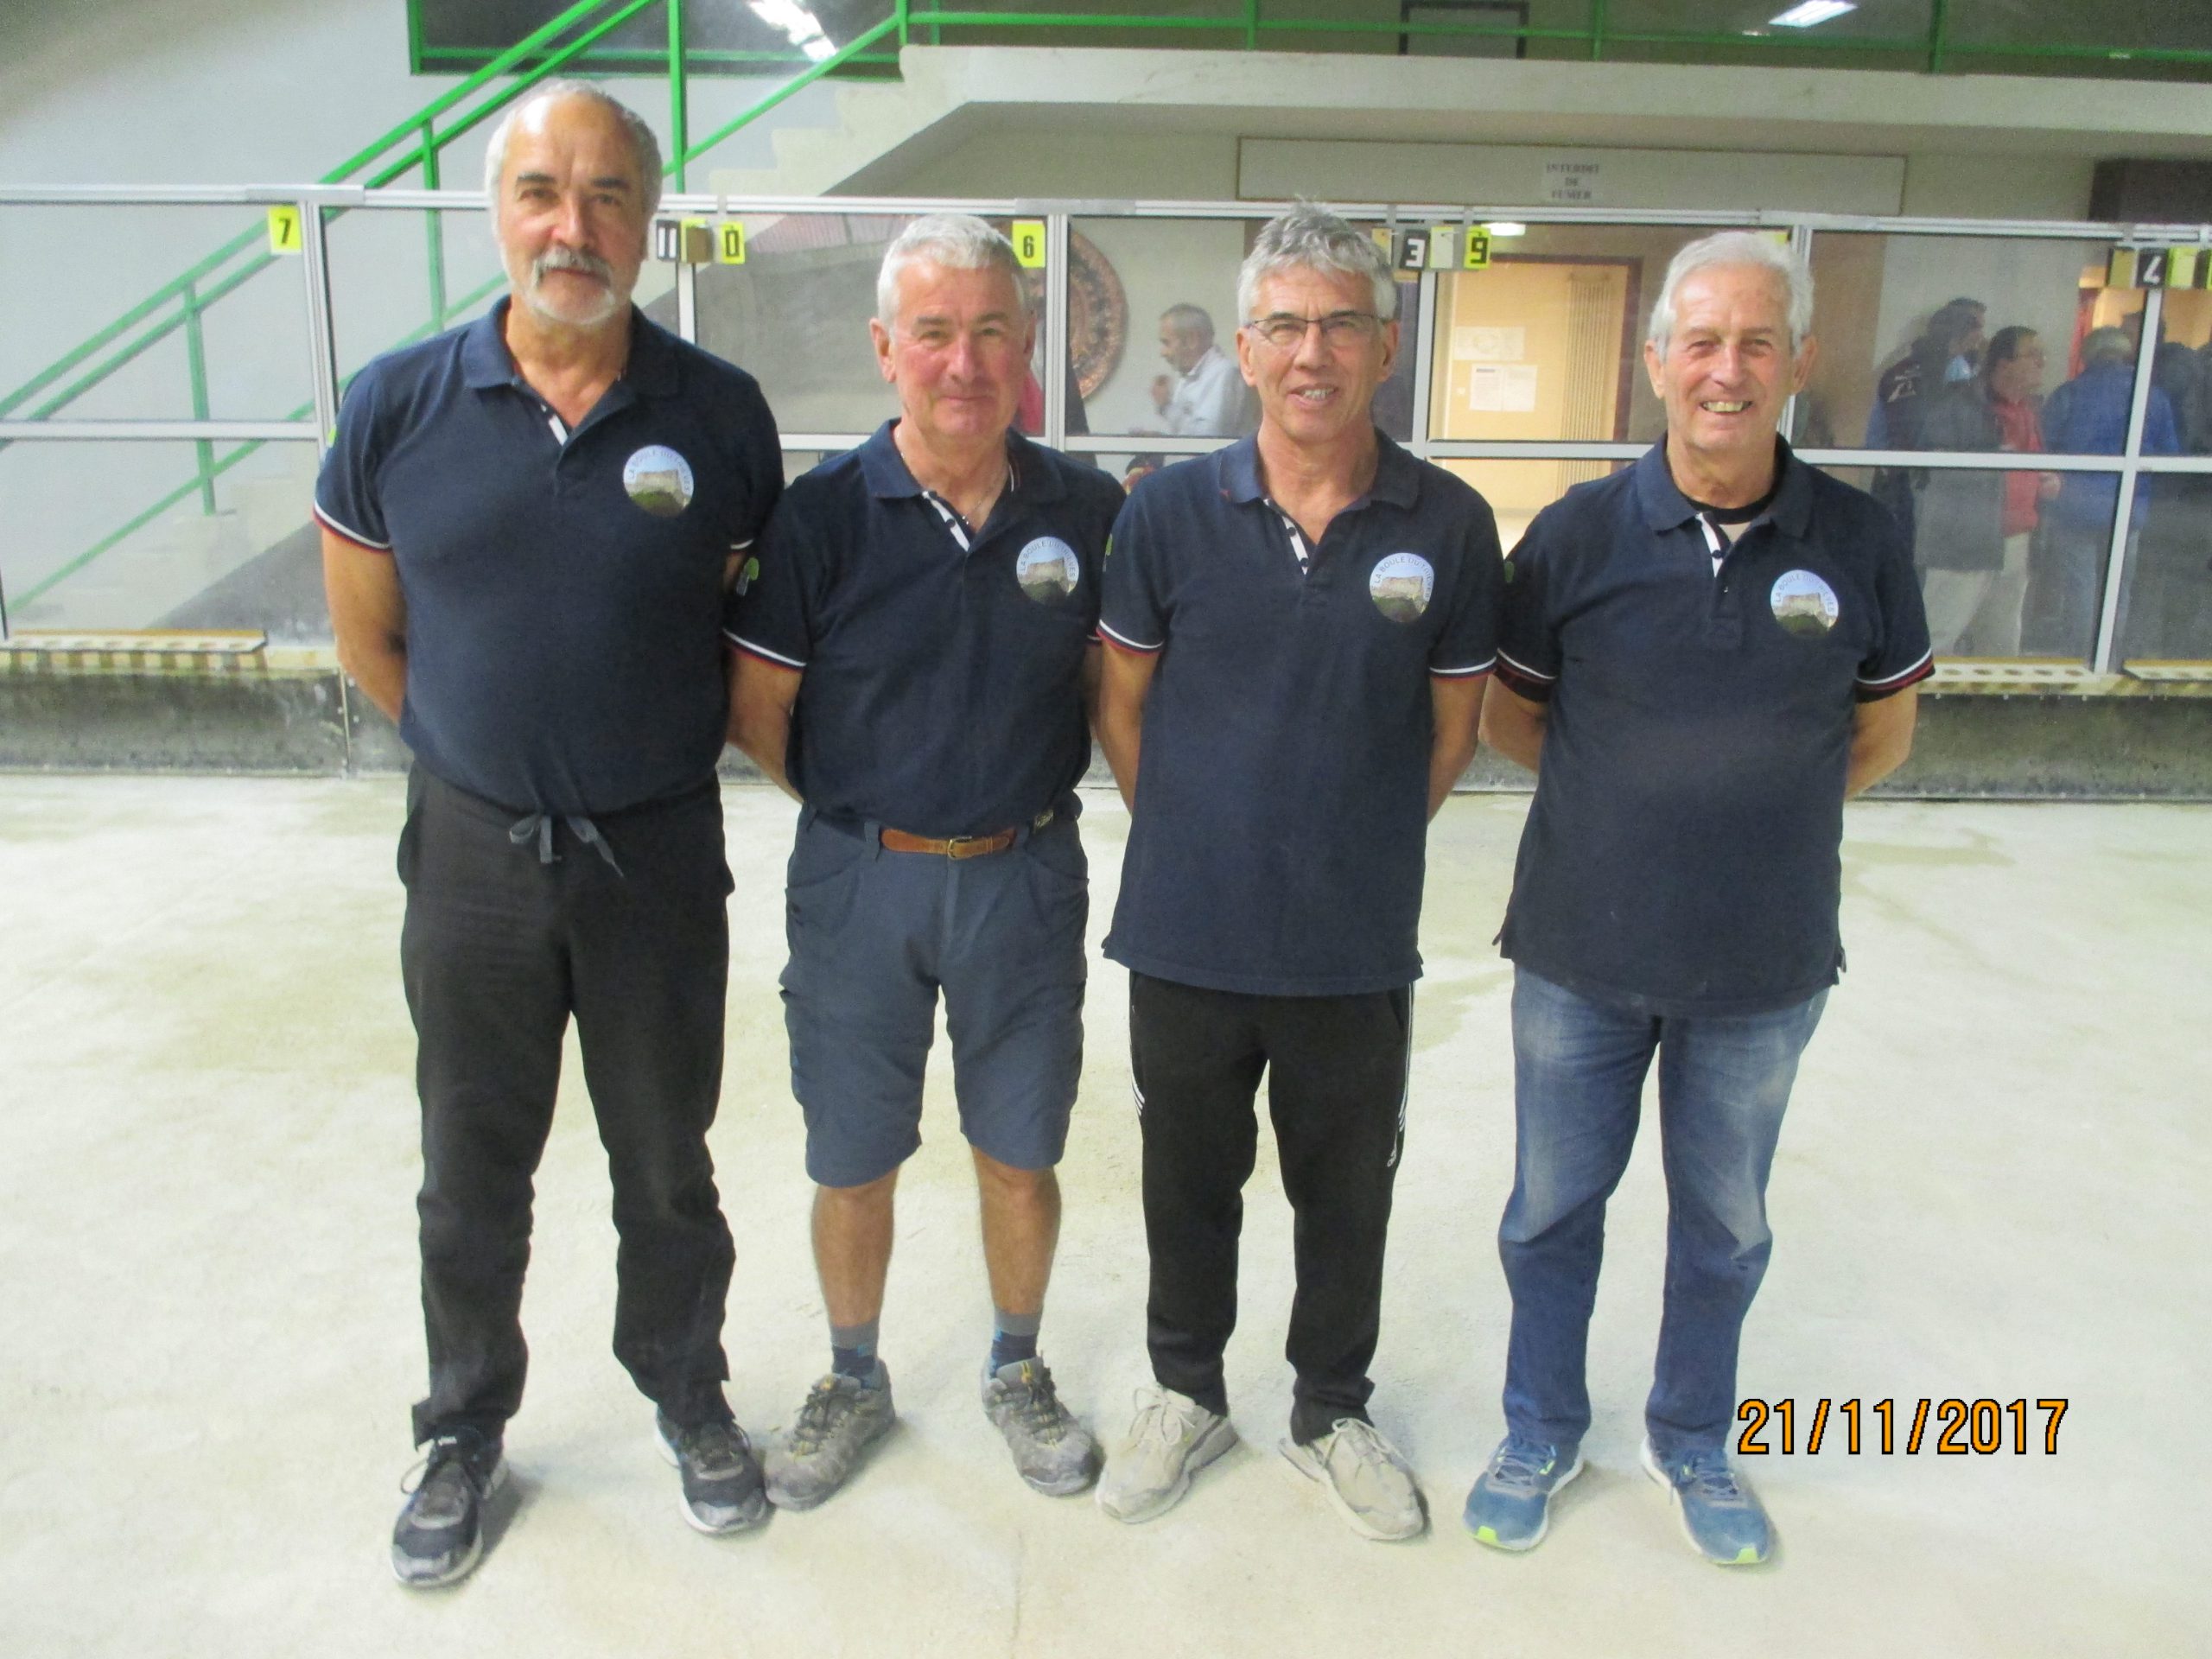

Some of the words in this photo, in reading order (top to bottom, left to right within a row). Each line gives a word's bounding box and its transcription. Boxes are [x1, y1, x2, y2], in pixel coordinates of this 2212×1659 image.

[278, 218, 291, 245] 7
[725, 231, 740, 257] 0
[1023, 235, 1035, 259] 6
[1405, 238, 1425, 268] 3
[1471, 238, 1488, 264] 9
[1380, 556, 1406, 573] BOULE
